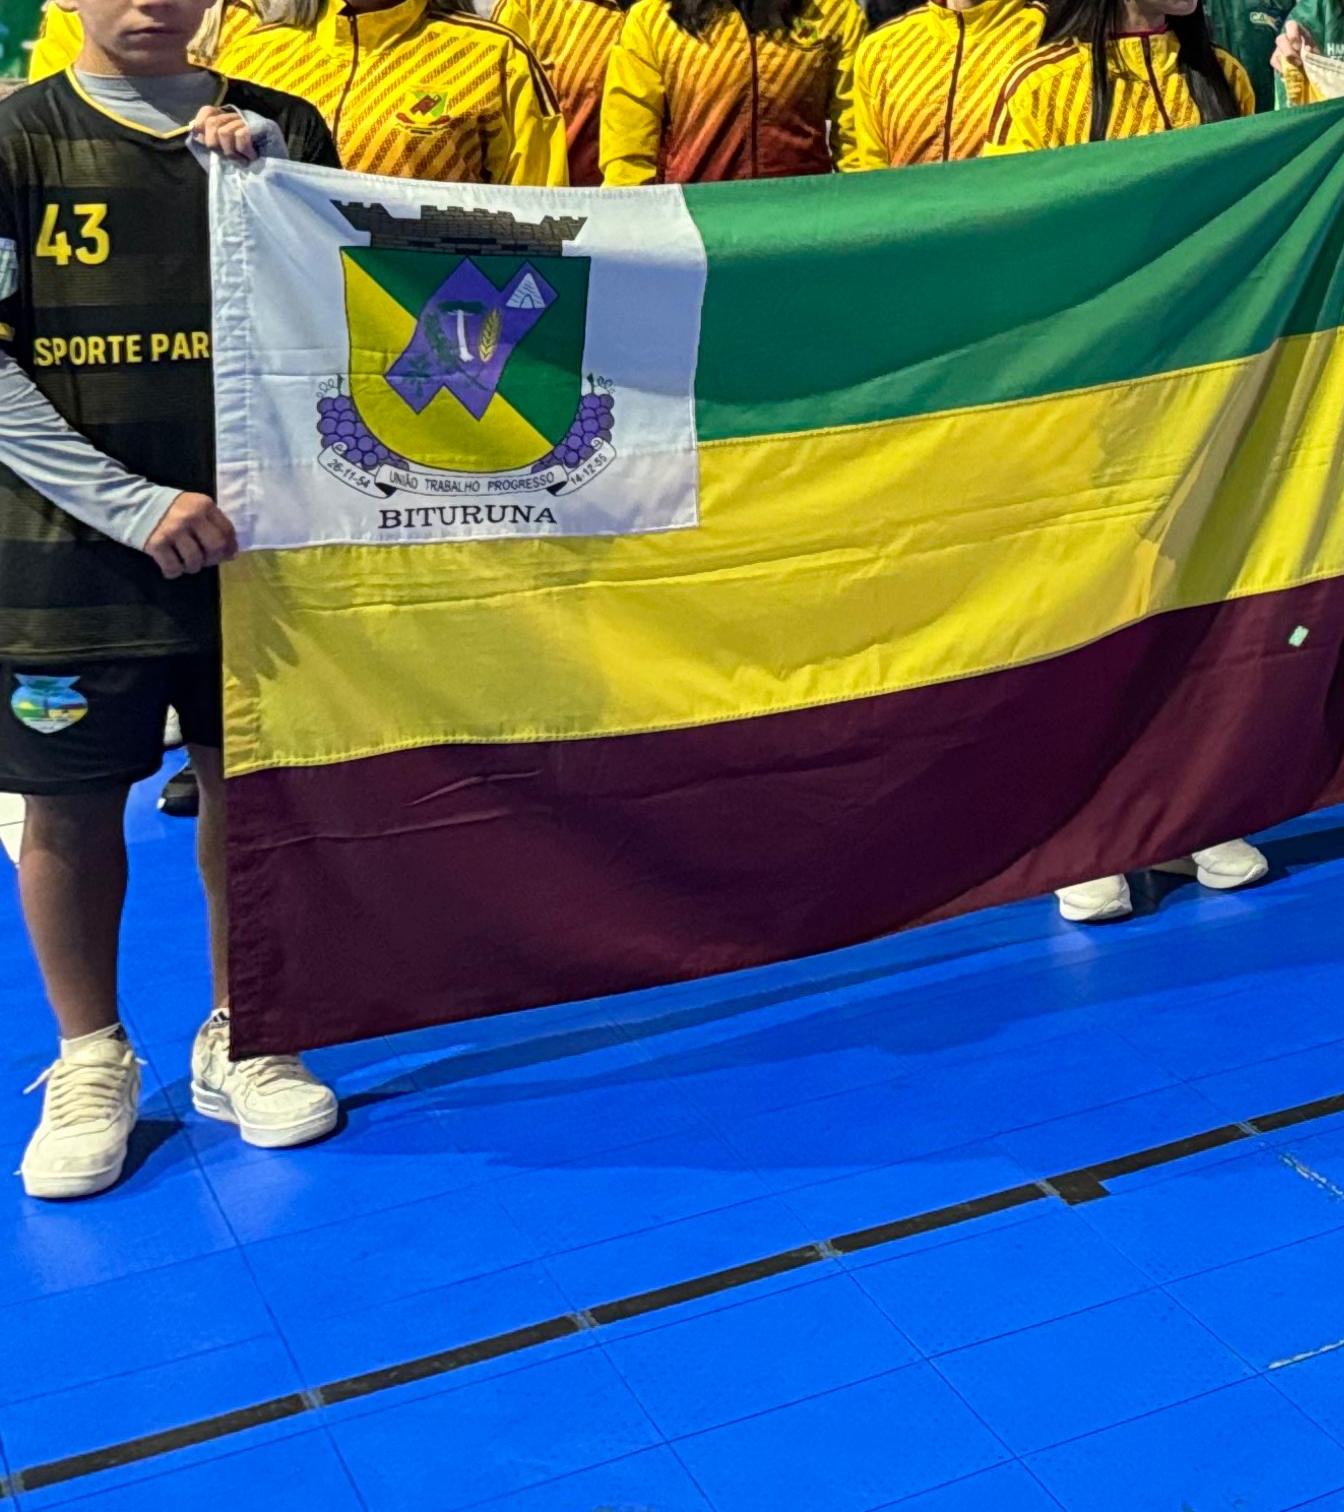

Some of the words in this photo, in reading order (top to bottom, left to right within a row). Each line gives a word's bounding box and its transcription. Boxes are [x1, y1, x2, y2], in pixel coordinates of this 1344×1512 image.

[35, 203, 111, 266] 43
[33, 334, 142, 367] SPORTE
[389, 470, 418, 489] UNIÃO
[425, 478, 480, 493] TRABALHO
[487, 471, 555, 491] PROGRESSO
[378, 504, 558, 529] BITURUNA
